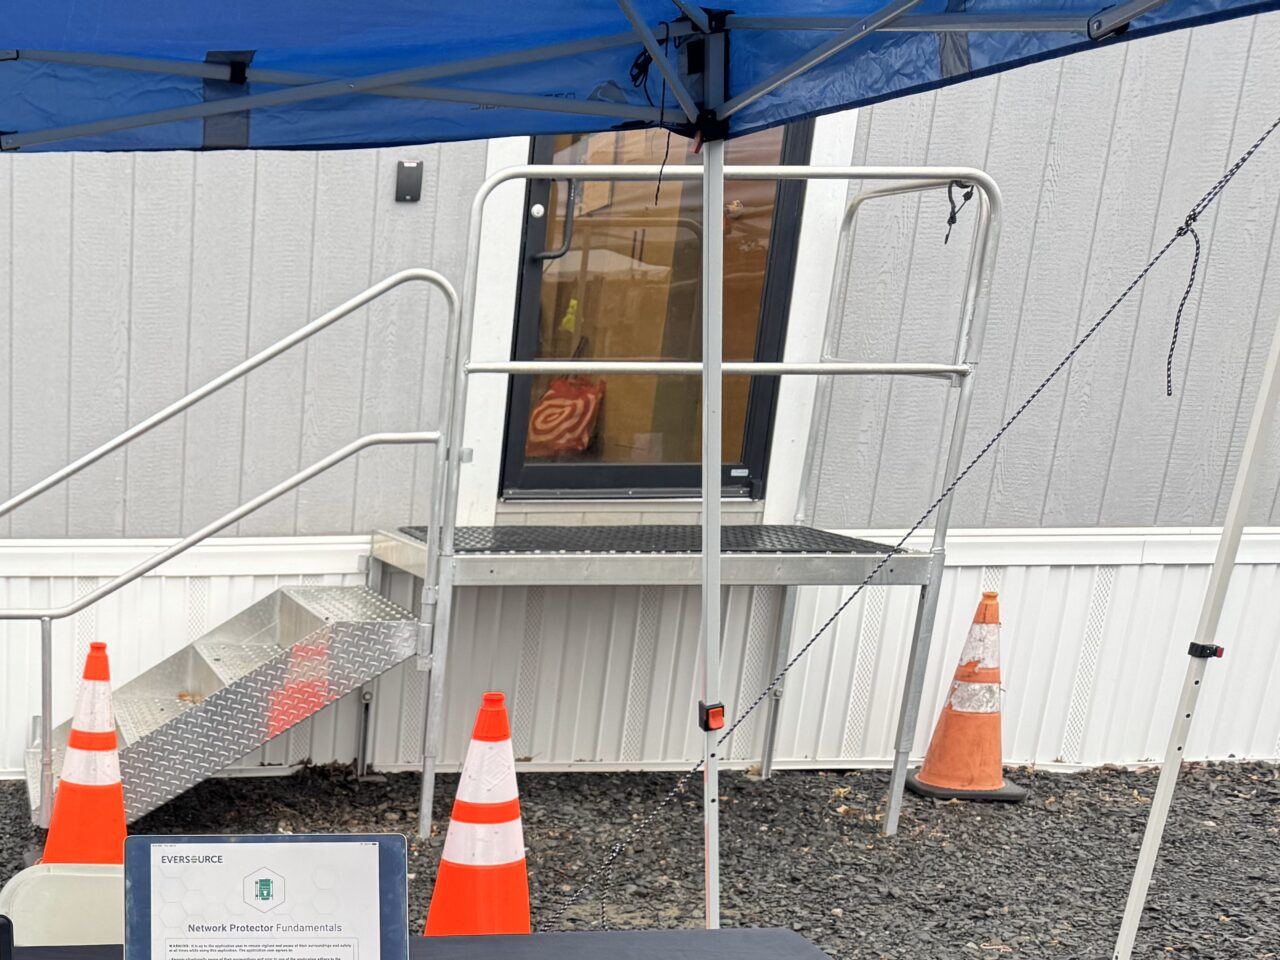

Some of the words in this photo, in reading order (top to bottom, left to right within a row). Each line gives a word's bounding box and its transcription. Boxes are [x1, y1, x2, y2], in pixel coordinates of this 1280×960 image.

[161, 855, 223, 864] EVERSOURCE
[188, 923, 227, 933] Network
[229, 923, 274, 933] Protector
[276, 923, 342, 932] Fundamentals
